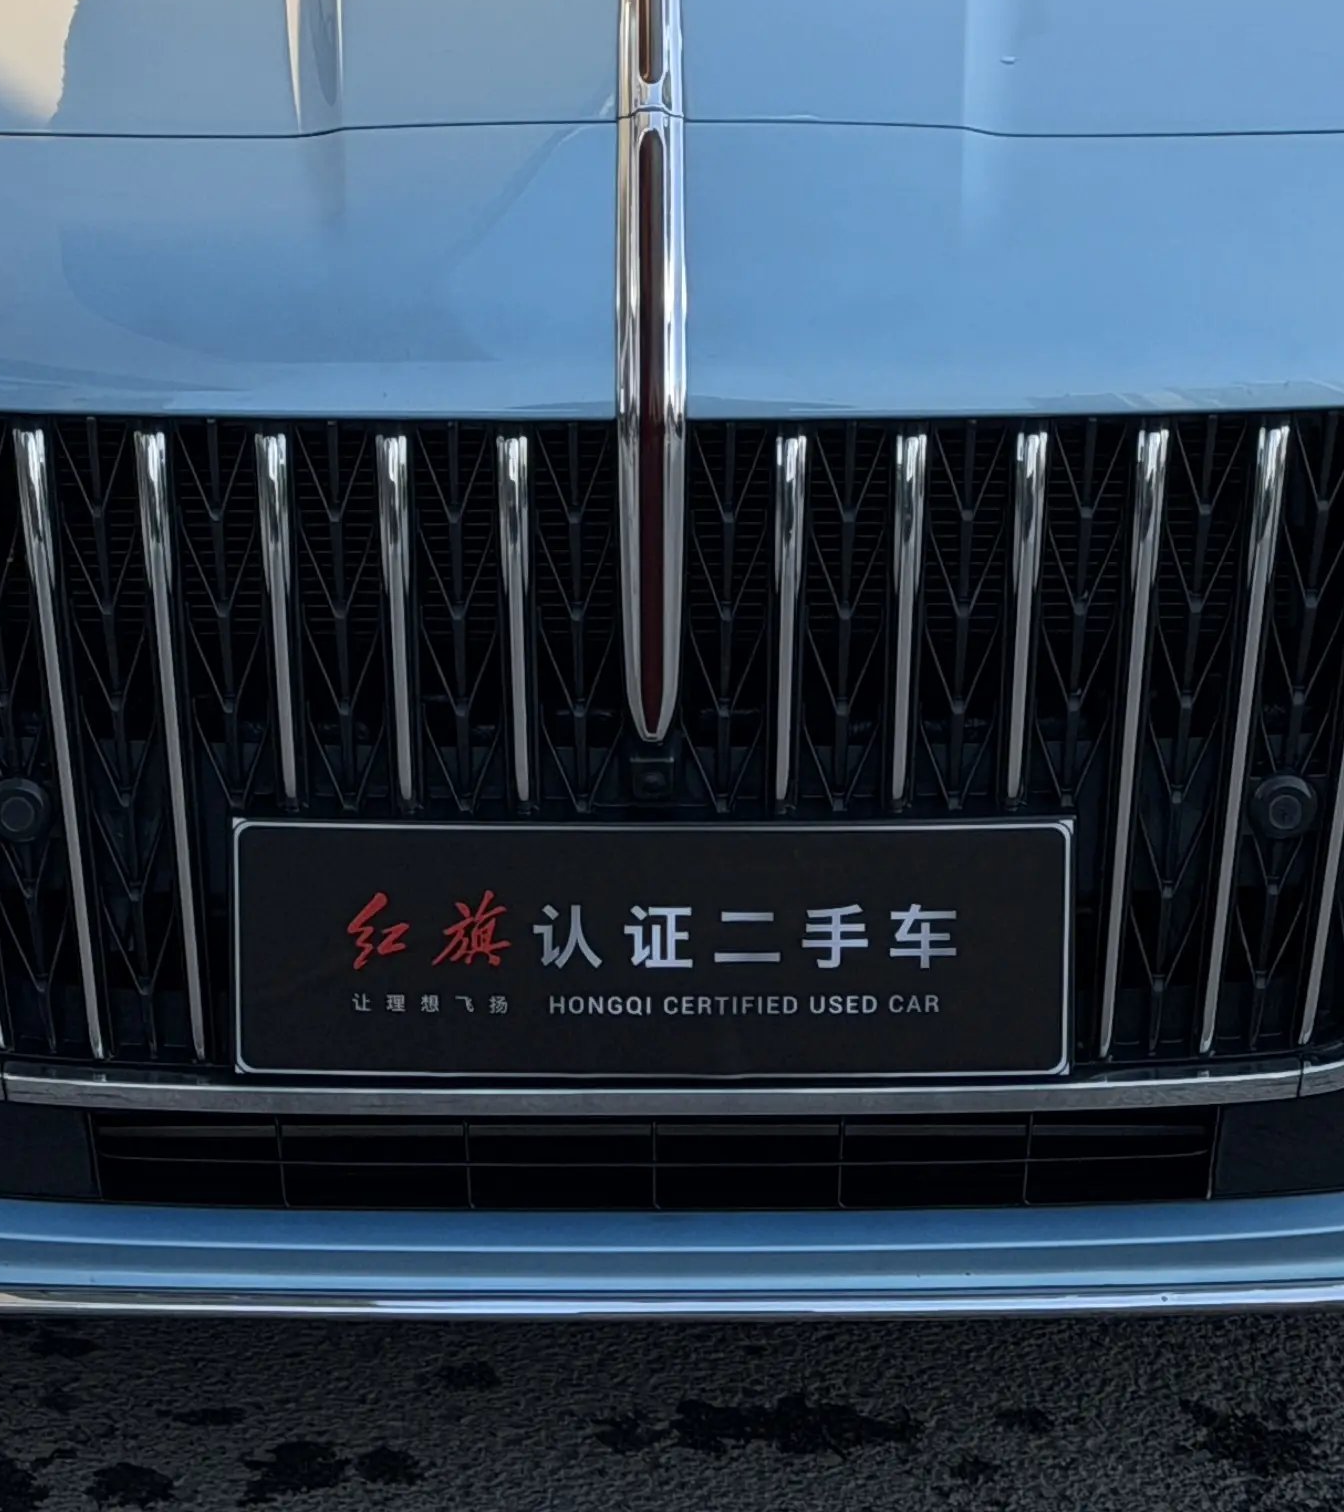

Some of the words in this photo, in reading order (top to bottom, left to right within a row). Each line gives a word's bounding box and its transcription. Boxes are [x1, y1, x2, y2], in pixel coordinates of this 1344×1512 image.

[351, 992, 509, 1015] 让理想飞扬
[548, 995, 653, 1016] HONGQI
[662, 995, 799, 1016] CERTIFIED
[809, 995, 879, 1015] USED
[888, 994, 941, 1014] CAR
